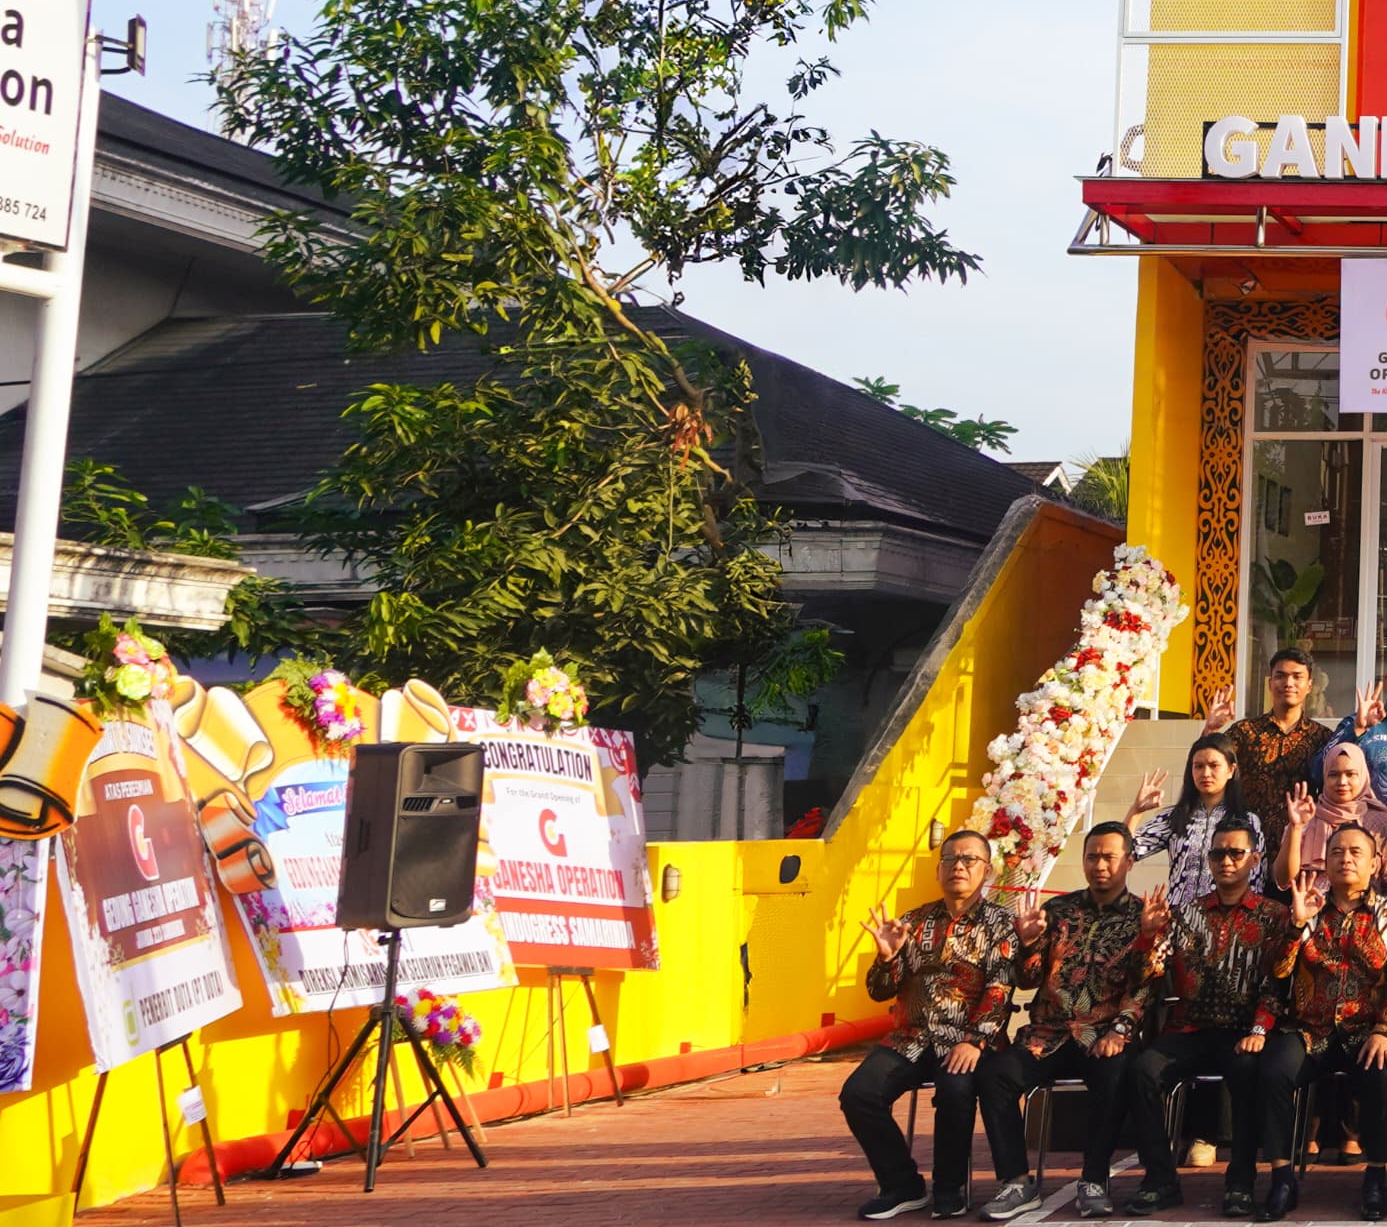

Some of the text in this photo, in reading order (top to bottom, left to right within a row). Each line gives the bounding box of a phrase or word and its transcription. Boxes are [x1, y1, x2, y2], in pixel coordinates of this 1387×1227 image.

[25, 202, 47, 221] 724
[481, 741, 593, 782] CONGRATULATION
[281, 785, 341, 816] Selamat
[493, 860, 625, 901] GANESHA OPERATION
[569, 915, 637, 950] SAMARINDA
